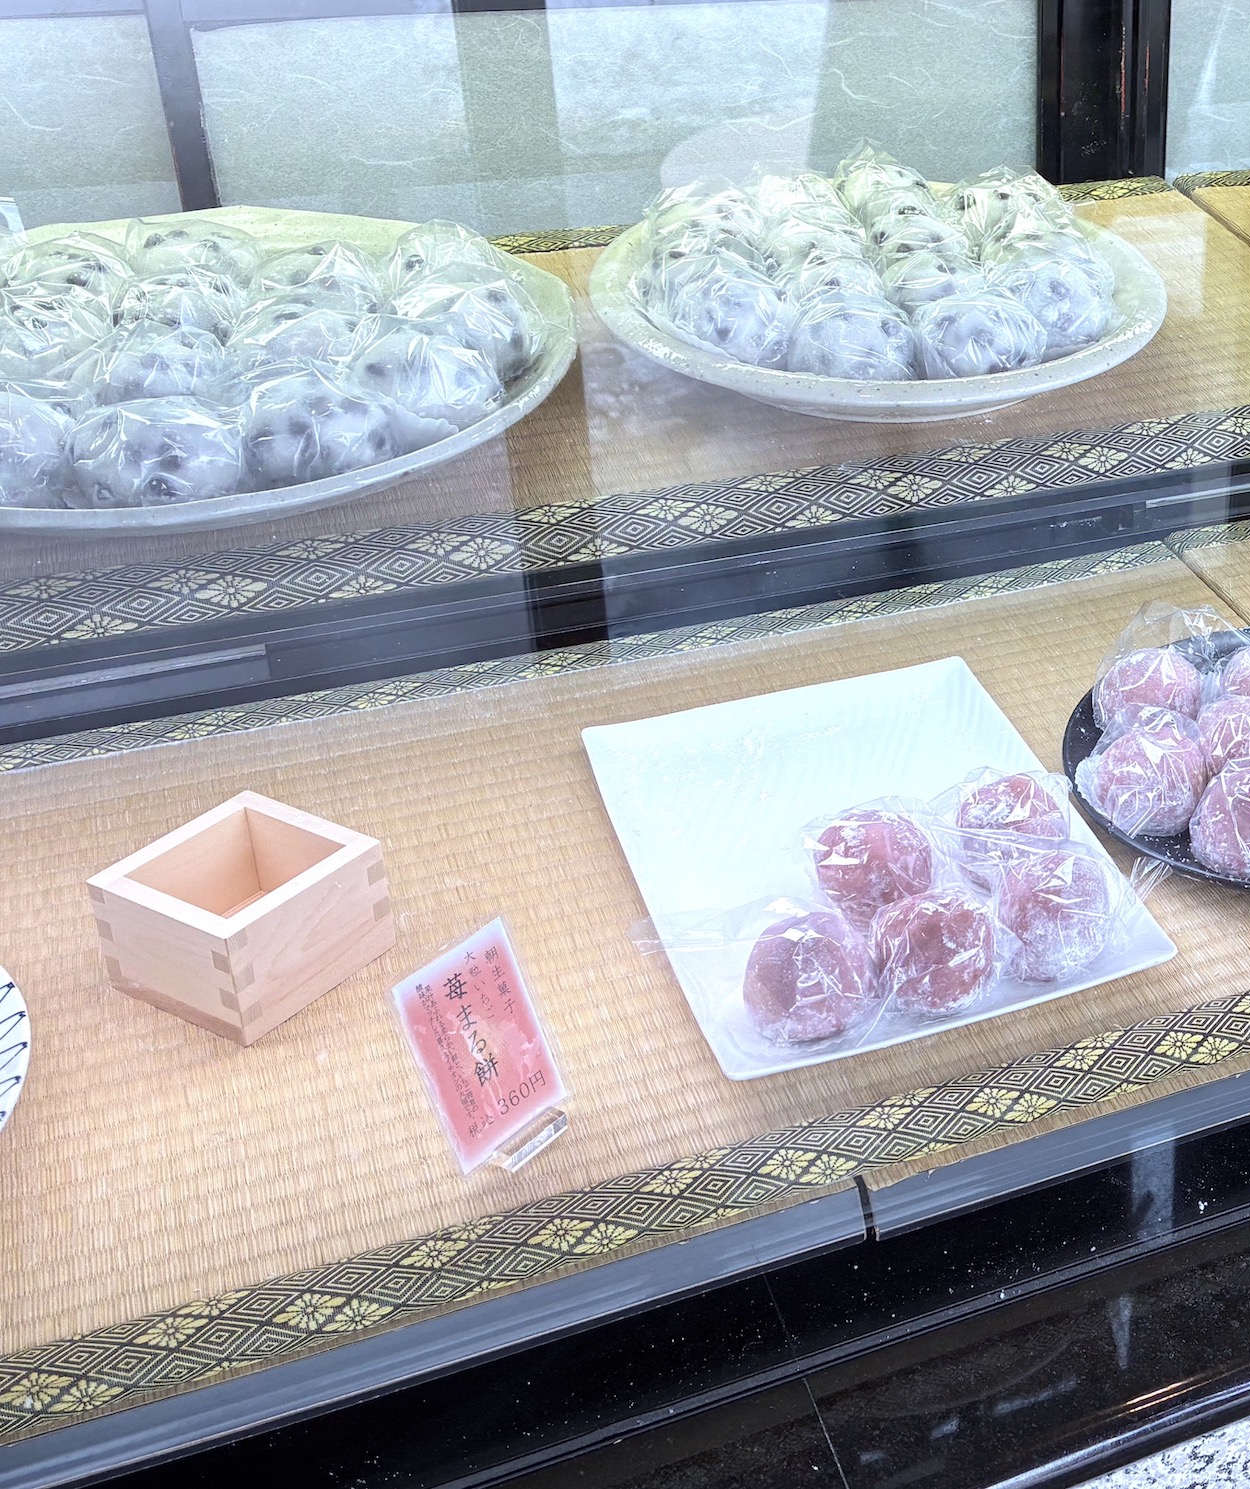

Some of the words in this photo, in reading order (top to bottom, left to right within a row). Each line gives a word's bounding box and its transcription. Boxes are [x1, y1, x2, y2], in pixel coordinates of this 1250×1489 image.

[463, 949, 496, 1020] 大粒いちご
[484, 946, 517, 1016] 朝生菓子
[442, 972, 500, 1087] 苺まる餅
[467, 1113, 494, 1138] 税込
[497, 1070, 547, 1116] 360円
